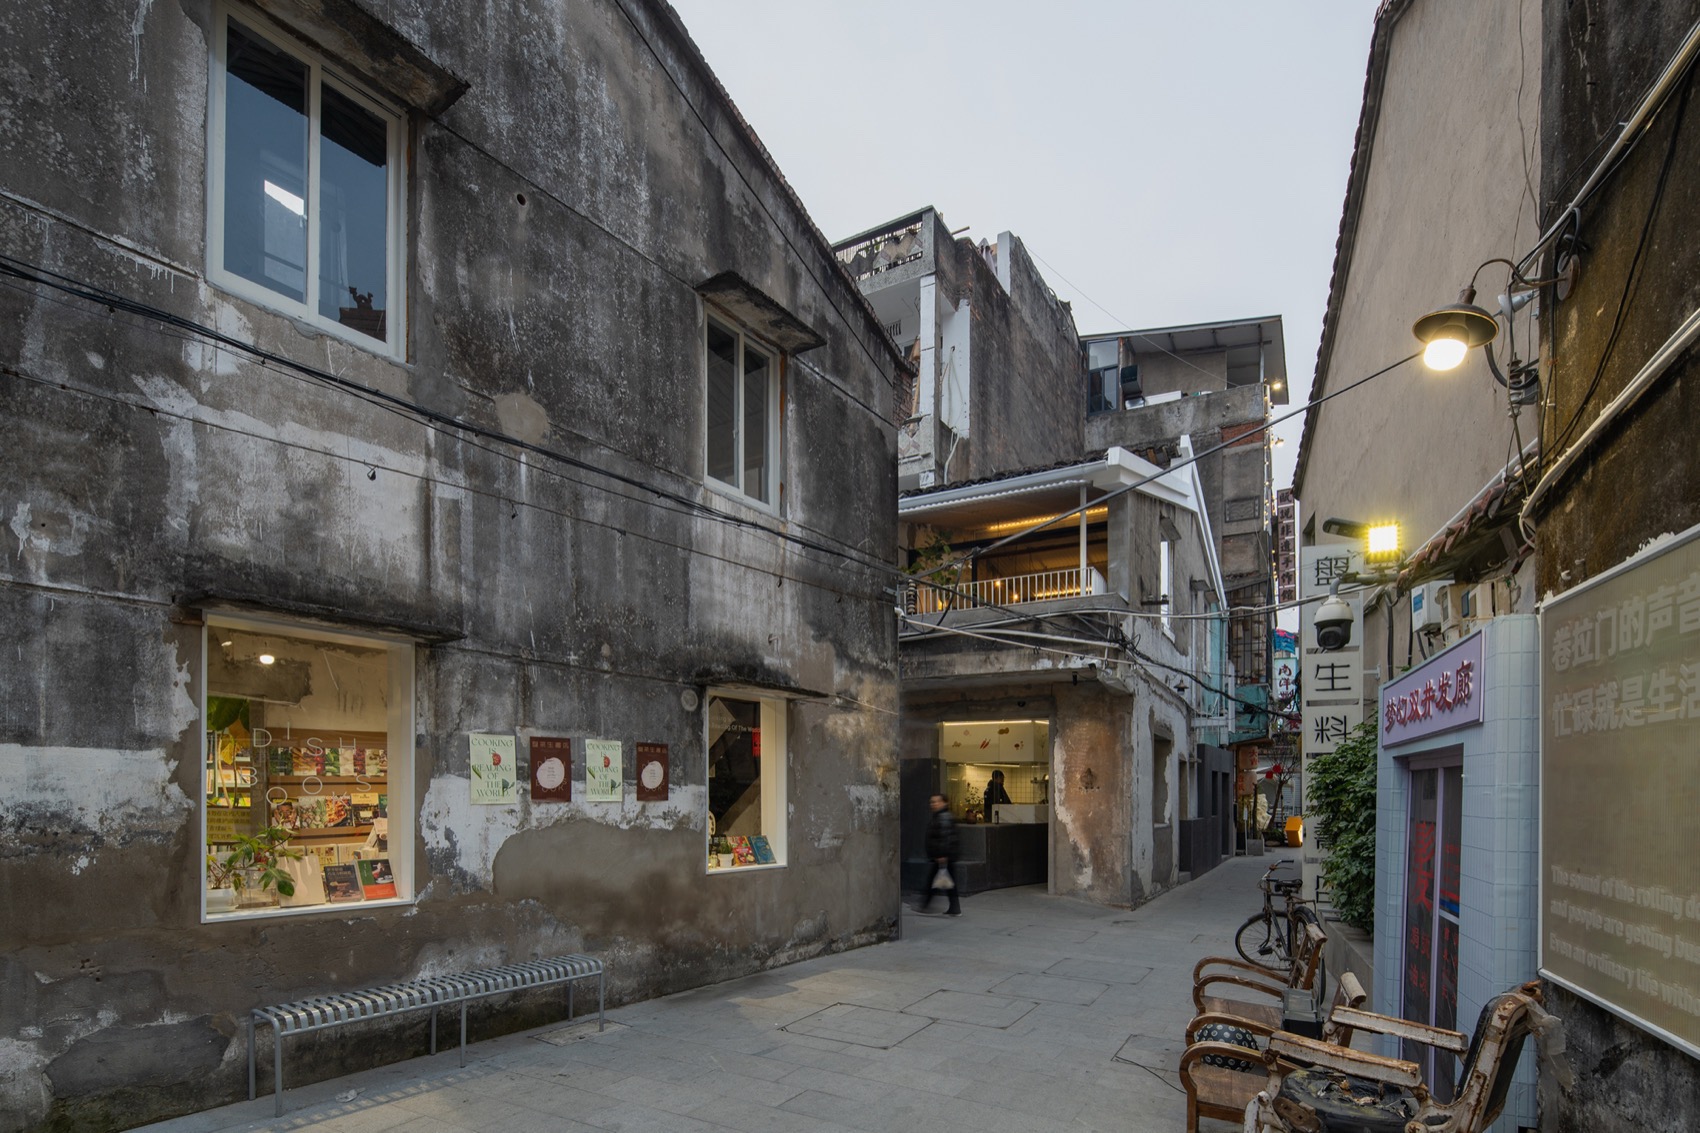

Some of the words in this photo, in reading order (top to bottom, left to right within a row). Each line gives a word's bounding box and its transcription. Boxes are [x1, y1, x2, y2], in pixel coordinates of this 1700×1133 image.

[1385, 660, 1474, 732] 梦幻双井发廊
[253, 721, 357, 757] DISH
[471, 737, 513, 747] COOKING
[587, 742, 620, 751] COOKING
[239, 766, 372, 808] BOOKS
[487, 772, 499, 780] OF
[1551, 865, 1569, 885] The
[1569, 871, 1601, 894] sound
[1601, 877, 1615, 897] of
[1614, 880, 1635, 903] the
[1636, 886, 1684, 920] rolling
[1550, 899, 1567, 918] and
[1568, 903, 1603, 930] people
[1603, 916, 1624, 937] are
[1625, 923, 1673, 959] getting
[1549, 932, 1572, 958] Even
[1586, 951, 1636, 989] ordinary
[1636, 968, 1659, 997] life
